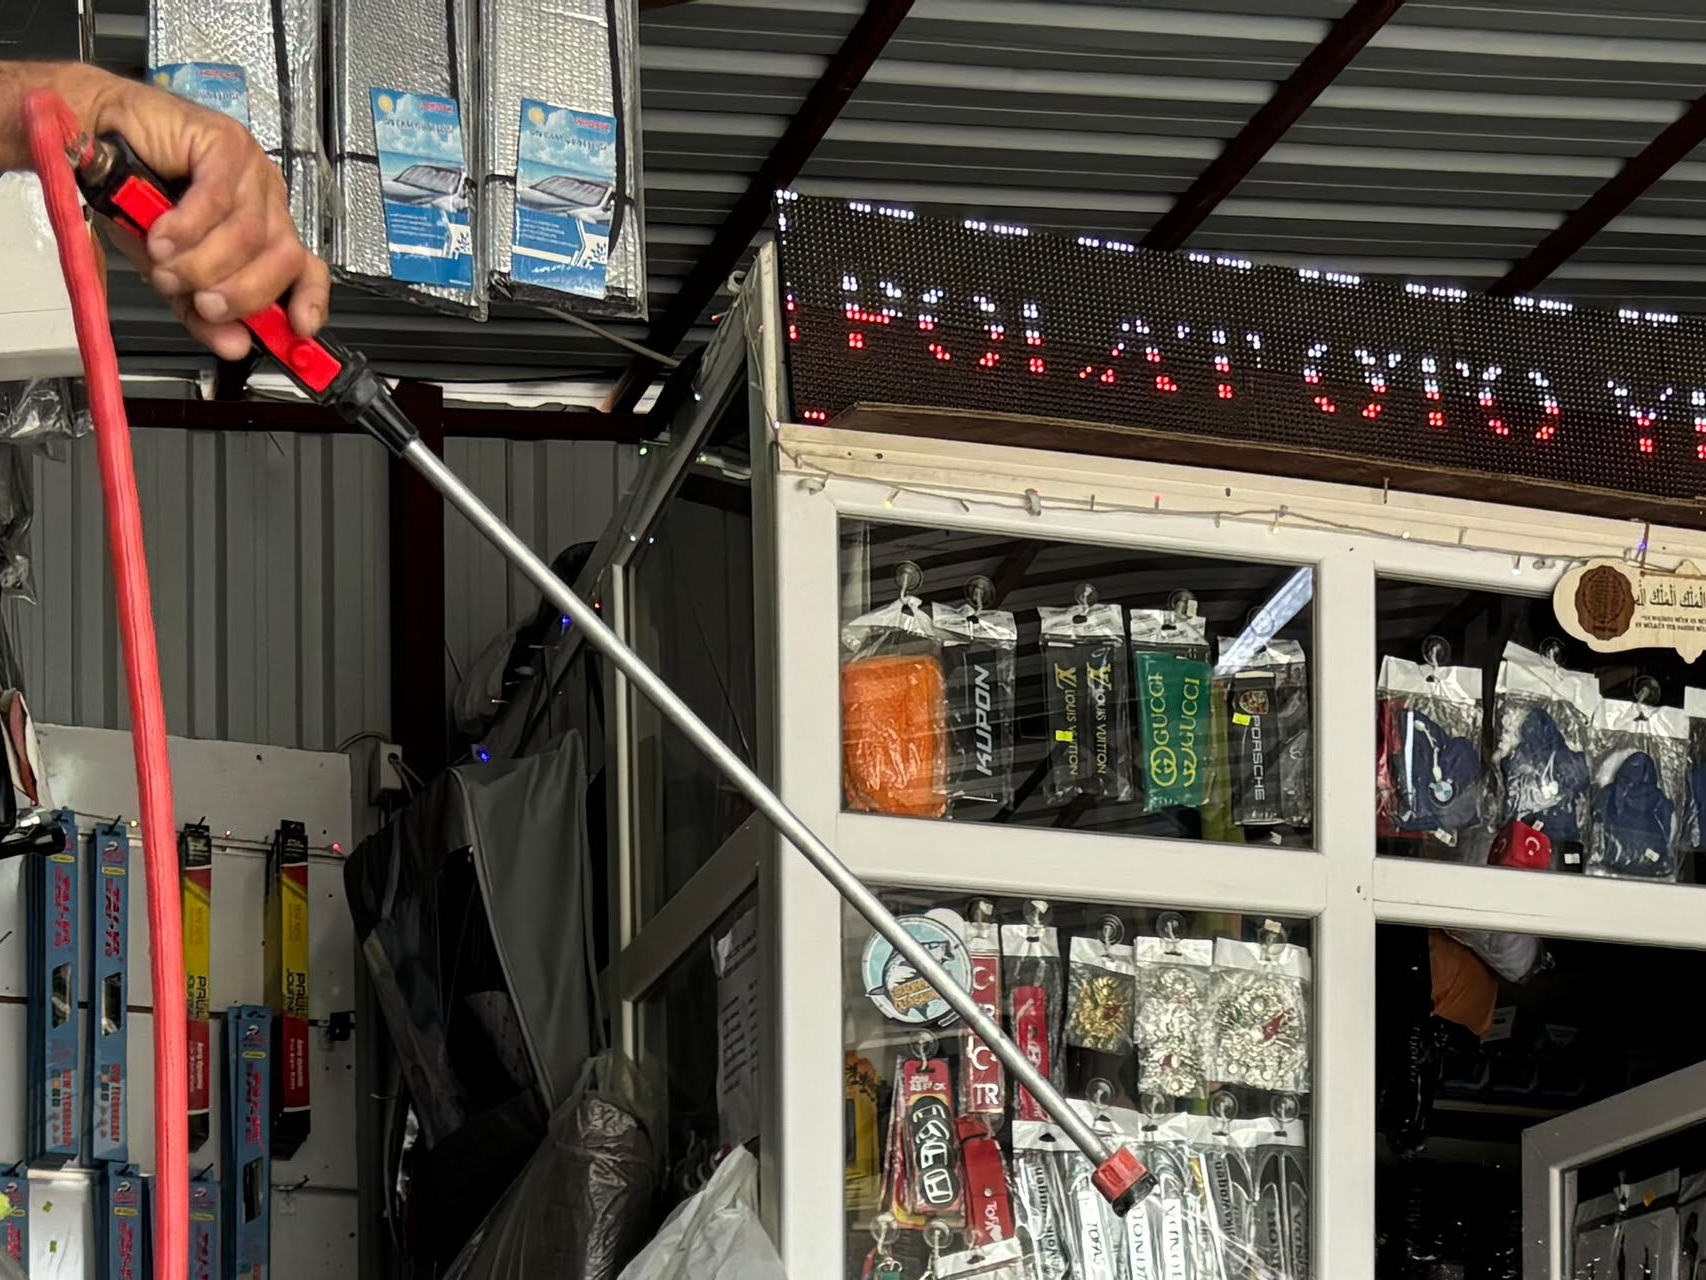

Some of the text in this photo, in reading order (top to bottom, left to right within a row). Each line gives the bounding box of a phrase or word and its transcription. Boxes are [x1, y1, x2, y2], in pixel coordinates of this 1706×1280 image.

[974, 664, 993, 777] KUPON
[1065, 690, 1077, 721] LOUIS
[1148, 672, 1170, 745] GUCCI
[1179, 677, 1200, 748] GUCCI
[1096, 723, 1108, 775] VUITTON
[1251, 716, 1266, 801] PORSCHE
[196, 975, 207, 1019] PAUL
[973, 1082, 999, 1106] TR
